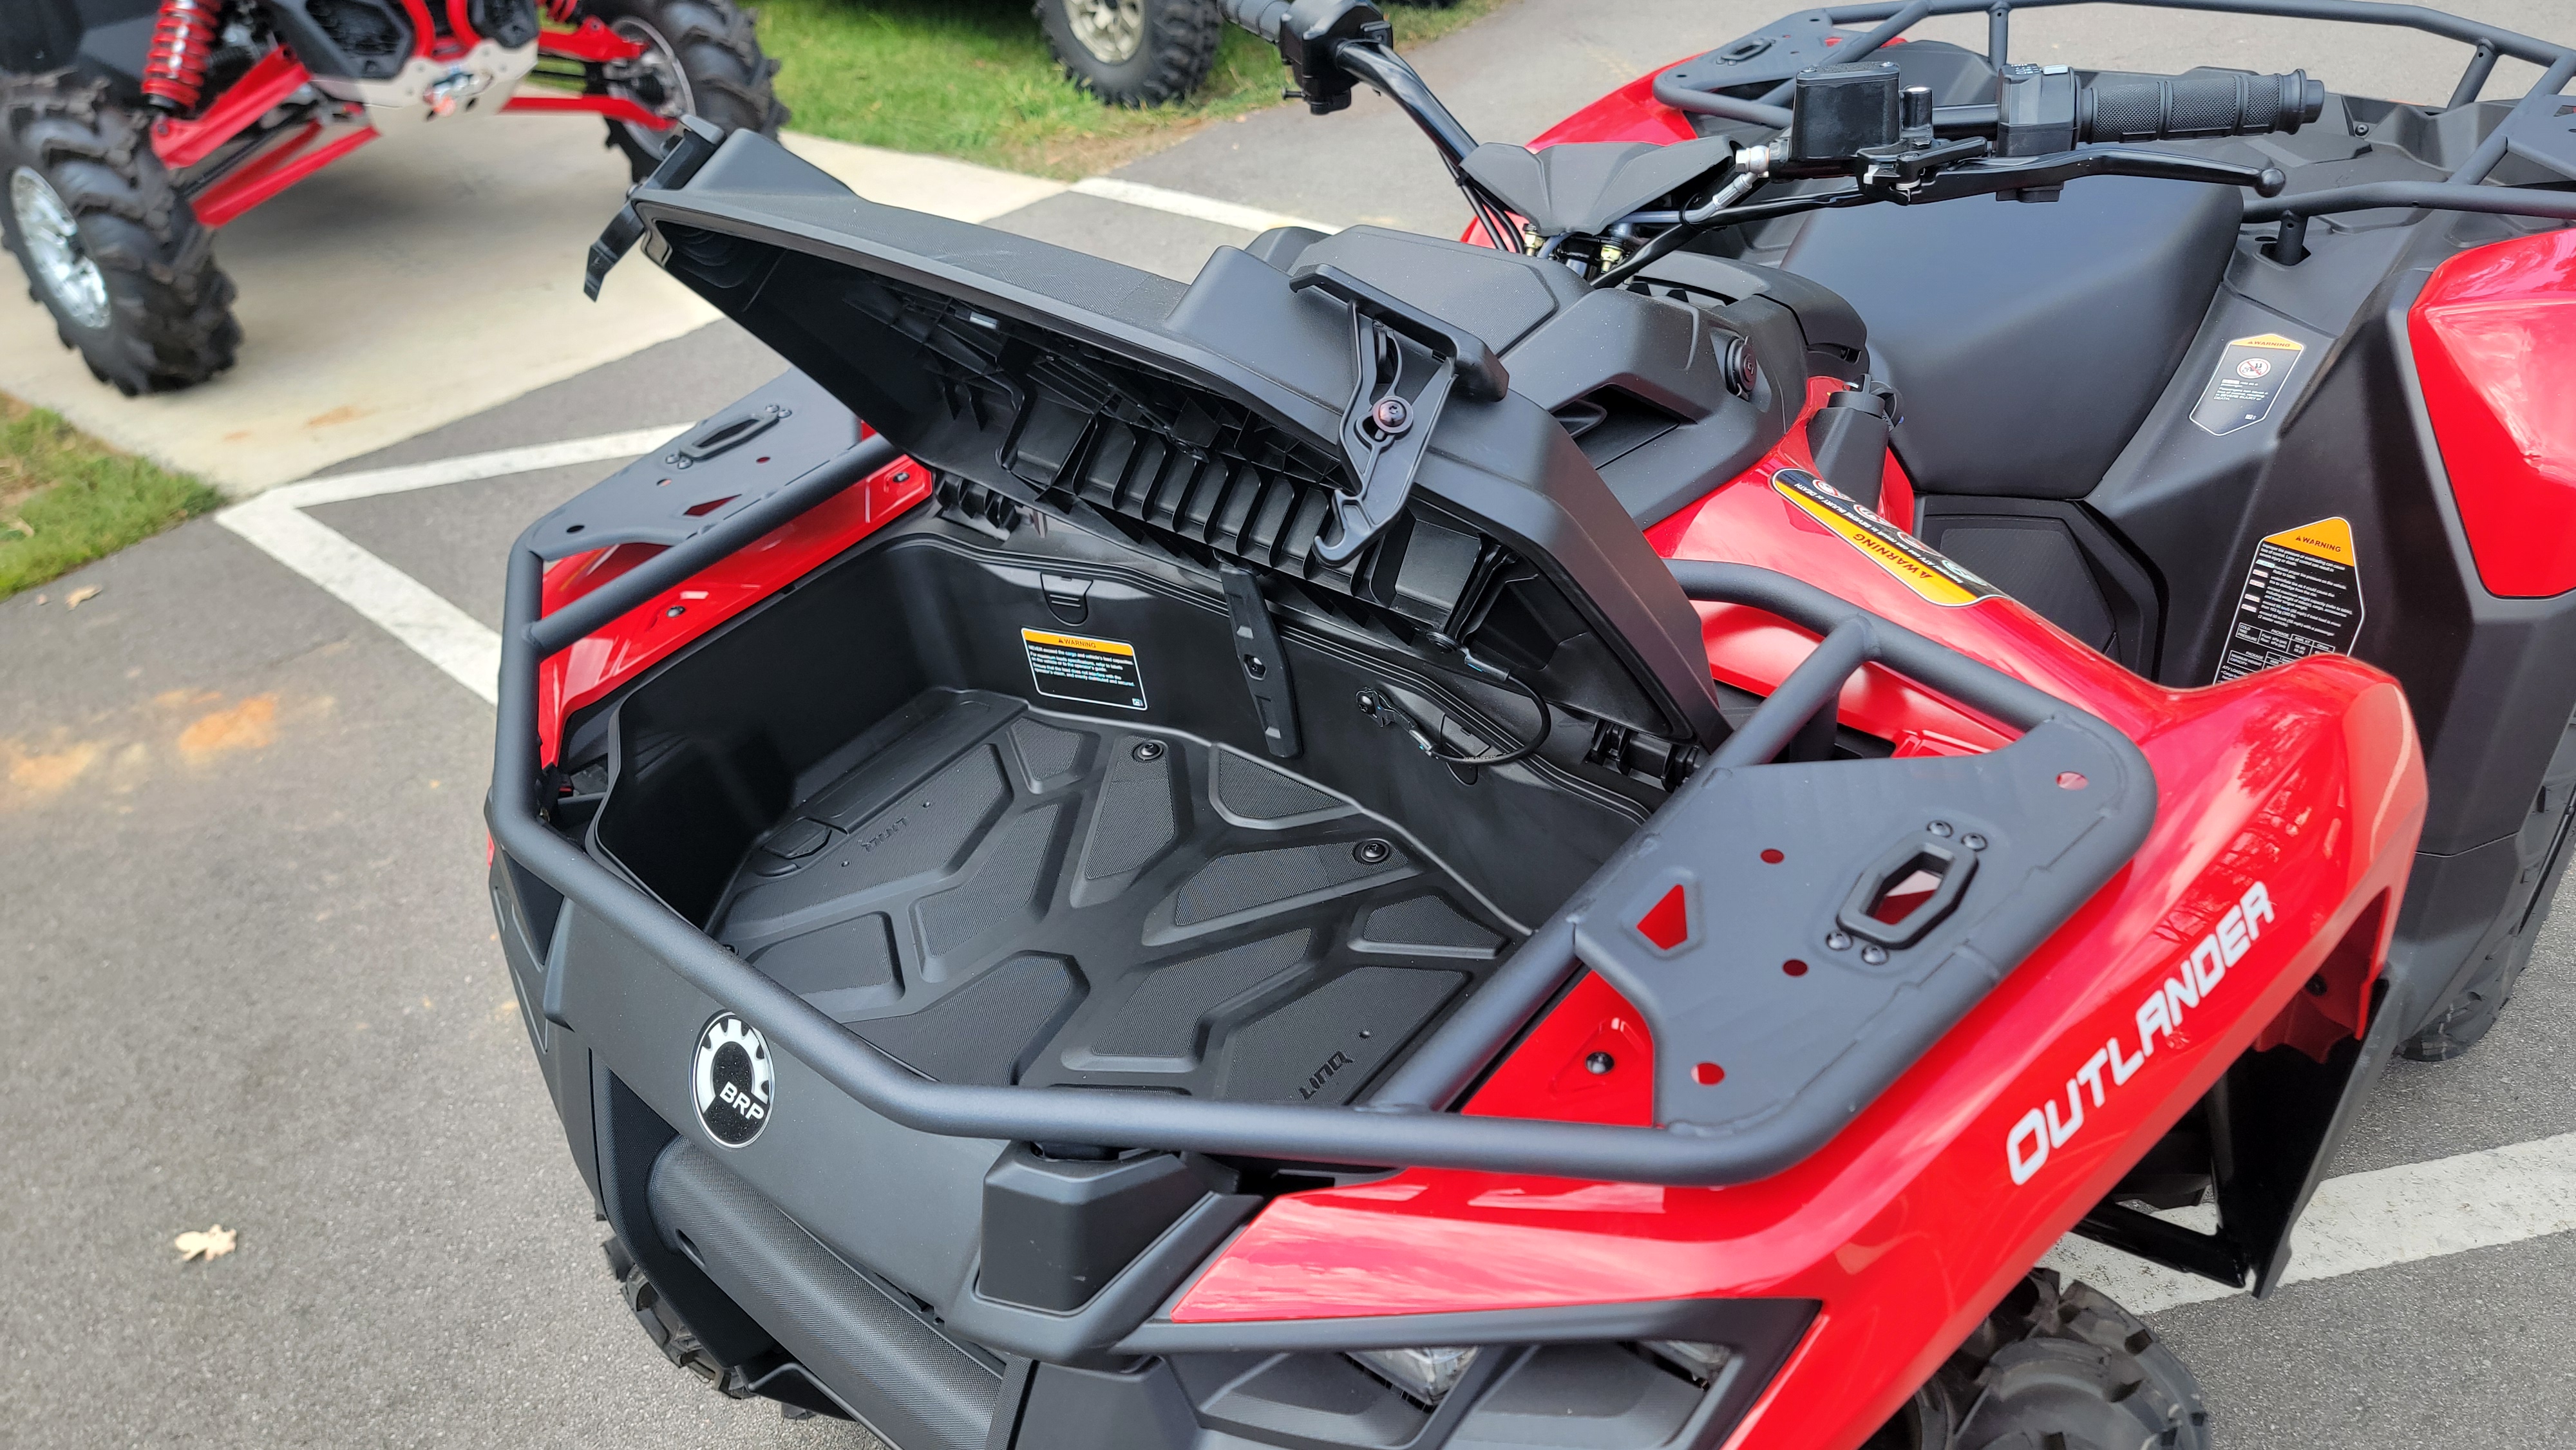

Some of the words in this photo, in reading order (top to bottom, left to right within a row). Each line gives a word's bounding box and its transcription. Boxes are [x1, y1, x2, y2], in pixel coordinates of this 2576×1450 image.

[1794, 483, 1815, 496] DEATH
[1821, 499, 1846, 513] INJURY
[1843, 512, 1872, 528] SEVERE
[2302, 536, 2341, 552] WARNING
[1853, 533, 1919, 573] WARNING
[1918, 557, 1935, 565] ATV
[1063, 638, 1097, 648] WARNING
[2006, 881, 2275, 1185] OUTLANDER
[719, 1081, 764, 1120] BRP
